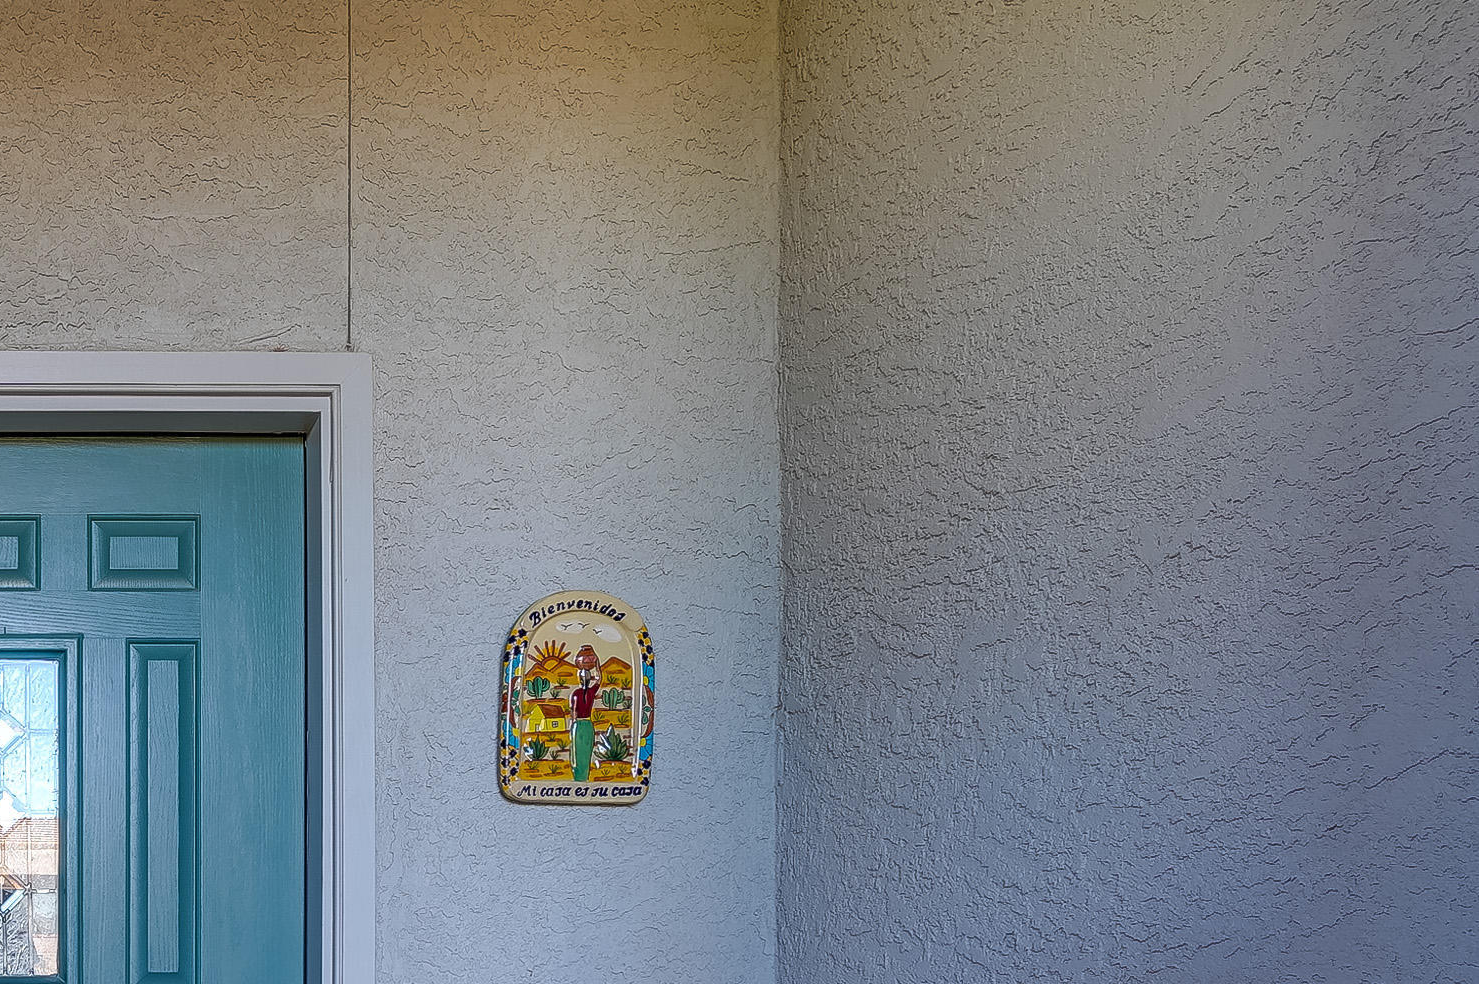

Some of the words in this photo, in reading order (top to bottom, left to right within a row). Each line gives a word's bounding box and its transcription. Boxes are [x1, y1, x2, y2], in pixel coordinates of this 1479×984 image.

[529, 600, 626, 628] Bienvenidos
[517, 785, 536, 797] Mi
[541, 786, 572, 797] casa
[575, 786, 589, 797] es
[592, 786, 608, 797] su
[612, 786, 642, 797] casa
